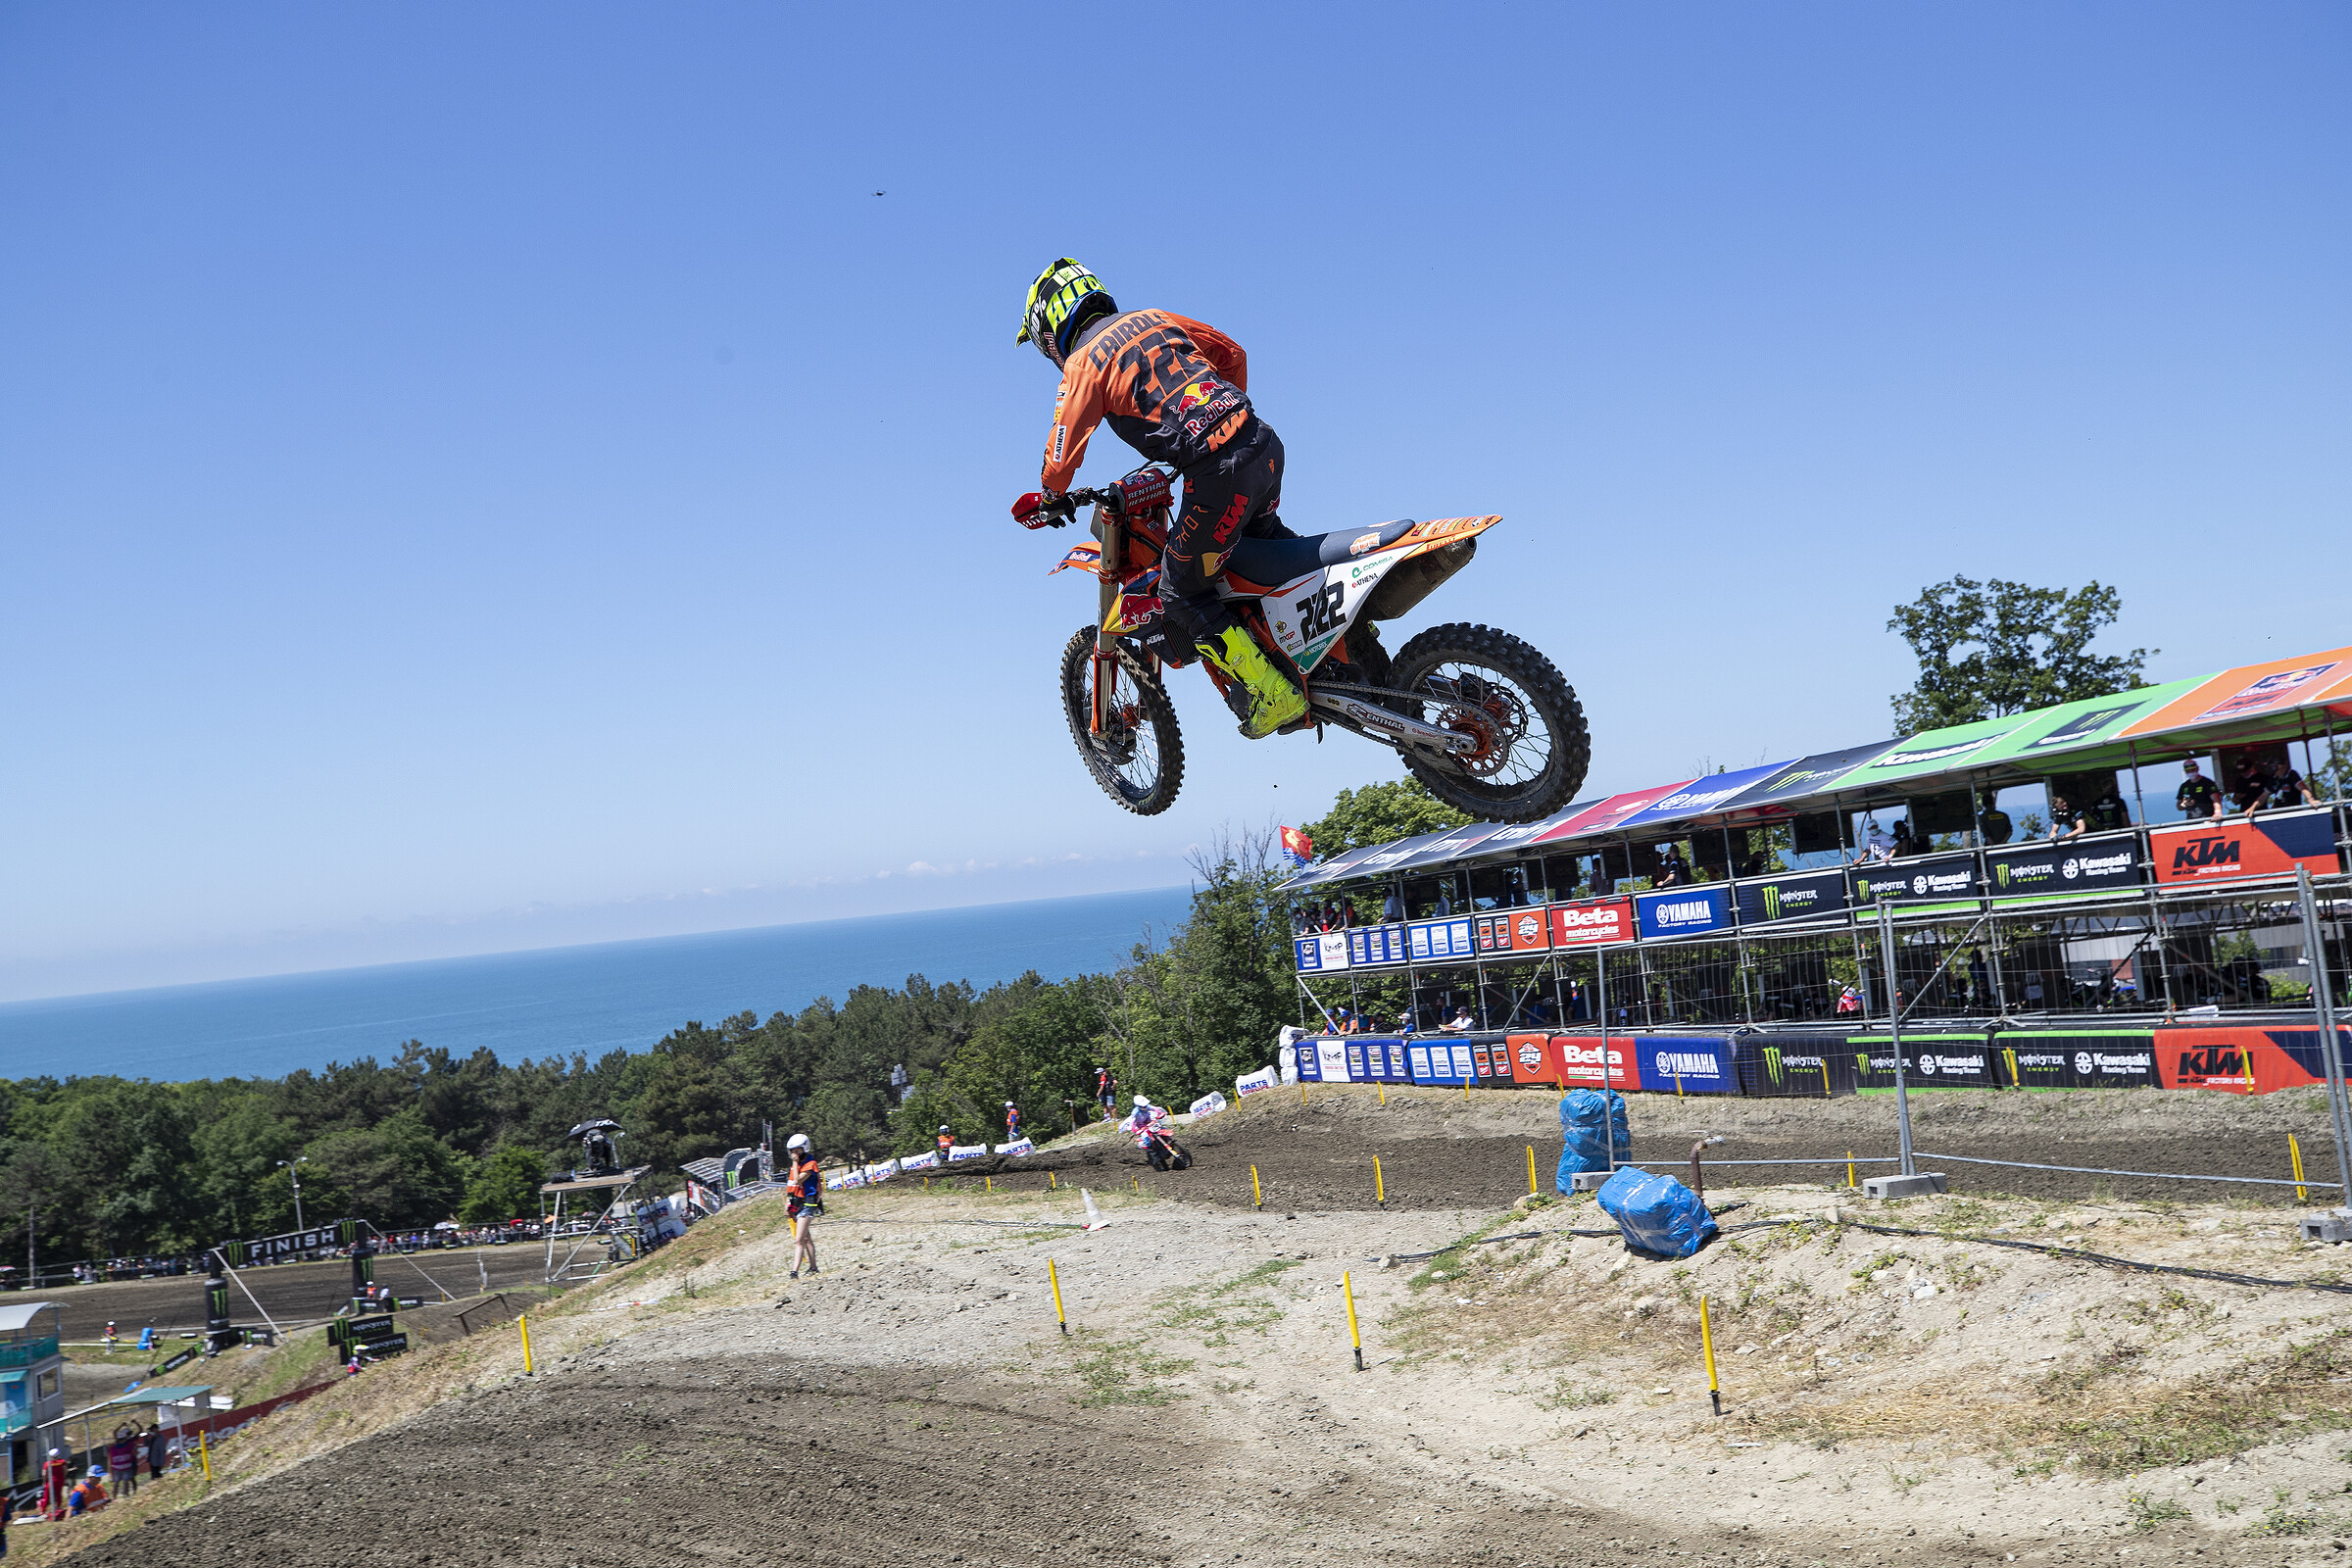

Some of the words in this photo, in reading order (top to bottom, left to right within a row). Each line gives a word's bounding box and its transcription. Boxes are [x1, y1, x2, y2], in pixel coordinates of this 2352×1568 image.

[1184, 406, 1214, 438] Red
[1211, 392, 1240, 416] Bull
[1206, 409, 1249, 453] KTM
[1055, 426, 1065, 455] ATHENA
[1128, 480, 1167, 500] RENTHAL
[1128, 489, 1166, 508] RENTHAL
[1213, 493, 1250, 545] KTM
[1356, 572, 1378, 587] ATHENA
[1296, 580, 1348, 644] 222
[1147, 634, 1165, 645] KTM
[2173, 836, 2240, 868] KTM
[2080, 853, 2132, 870] Kawasaki
[1928, 870, 1972, 887] Kawasaki
[2010, 863, 2054, 878] MONSTER
[2085, 867, 2107, 877] Racing
[2108, 865, 2127, 874] Team
[1869, 880, 1907, 893] MONSTER
[1933, 884, 1952, 893] Racing
[1953, 882, 1967, 891] Team
[1779, 889, 1818, 903] MONSTER
[1562, 907, 1618, 928] Beta
[1668, 900, 1711, 922] YAMAHA
[1565, 925, 1619, 940] motorcycles
[1563, 1045, 1623, 1064] Beta
[1782, 1056, 1823, 1067] MONSTER
[1935, 1054, 1984, 1067] Kawasaki
[2018, 1054, 2065, 1066] MONSTER
[2092, 1052, 2151, 1067] Kawasaki
[2177, 1045, 2253, 1075] KTM
[1669, 1054, 1719, 1074] YAMAHA
[1941, 1066, 1964, 1075] Racing
[2129, 1065, 2147, 1074] Team
[1239, 1079, 1268, 1092] PARTS
[1194, 1101, 1211, 1113] PARTS
[251, 1230, 334, 1257] FINISH
